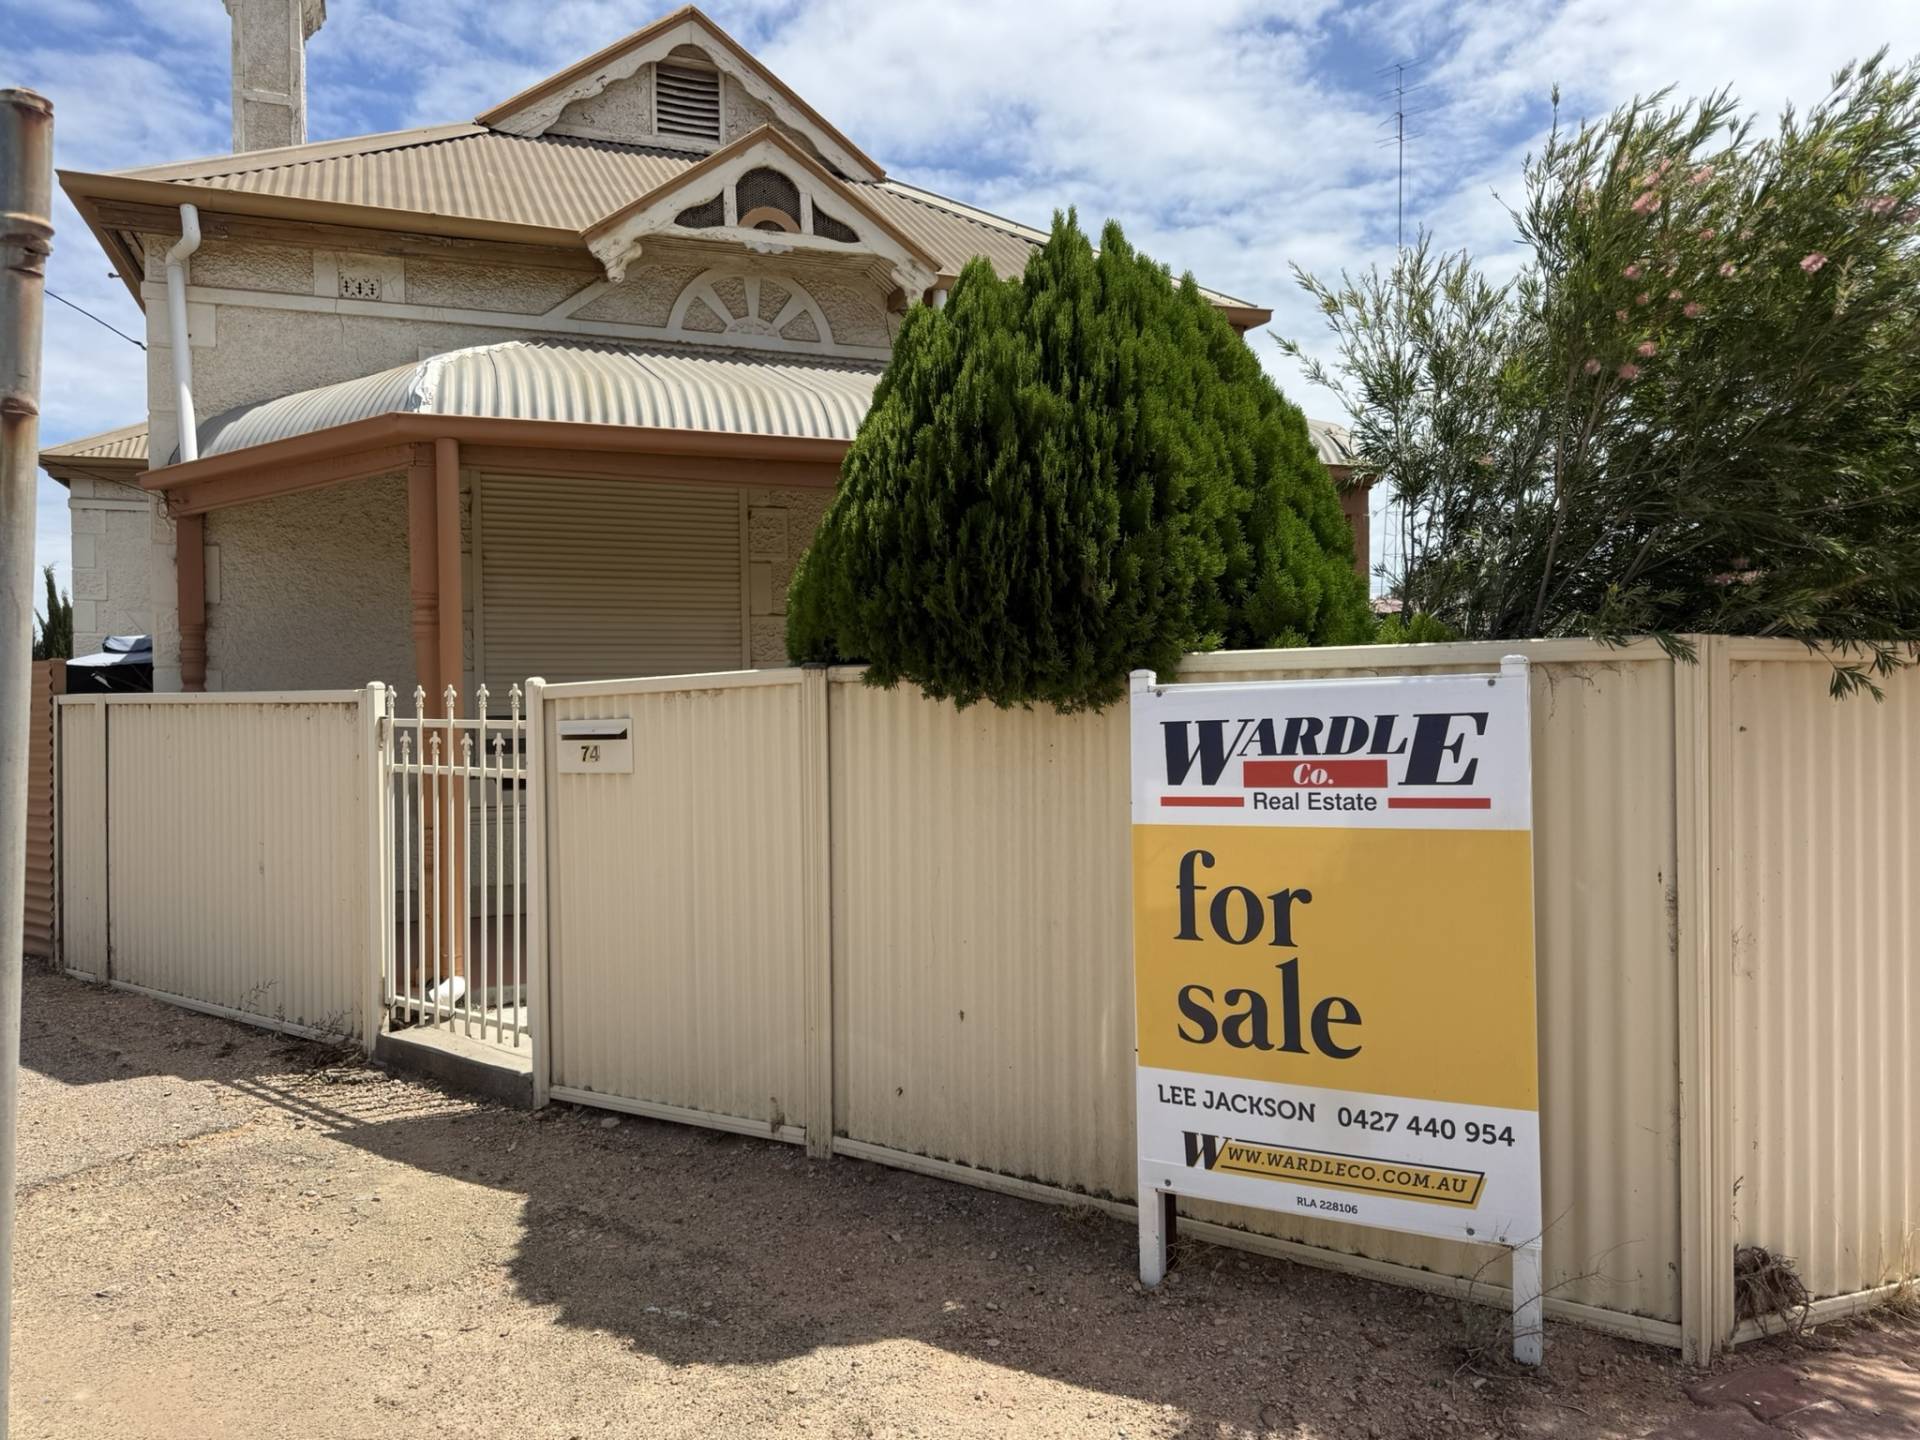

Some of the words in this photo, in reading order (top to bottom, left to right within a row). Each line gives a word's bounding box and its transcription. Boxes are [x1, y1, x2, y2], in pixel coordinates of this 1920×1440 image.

[581, 745, 600, 762] 74
[1160, 712, 1489, 786] WARDLE
[1293, 763, 1334, 785] Co.
[1253, 792, 1299, 810] Real
[1308, 792, 1377, 811] Estate
[1173, 849, 1312, 947] for
[1177, 957, 1363, 1060] sale
[1157, 1084, 1196, 1106] LEE
[1203, 1090, 1316, 1122] JACKSON
[1337, 1107, 1399, 1133] 0427
[1406, 1116, 1456, 1140] 440
[1464, 1122, 1516, 1147] 954
[1296, 1196, 1317, 1208] RLA
[1320, 1200, 1358, 1214] 228106
